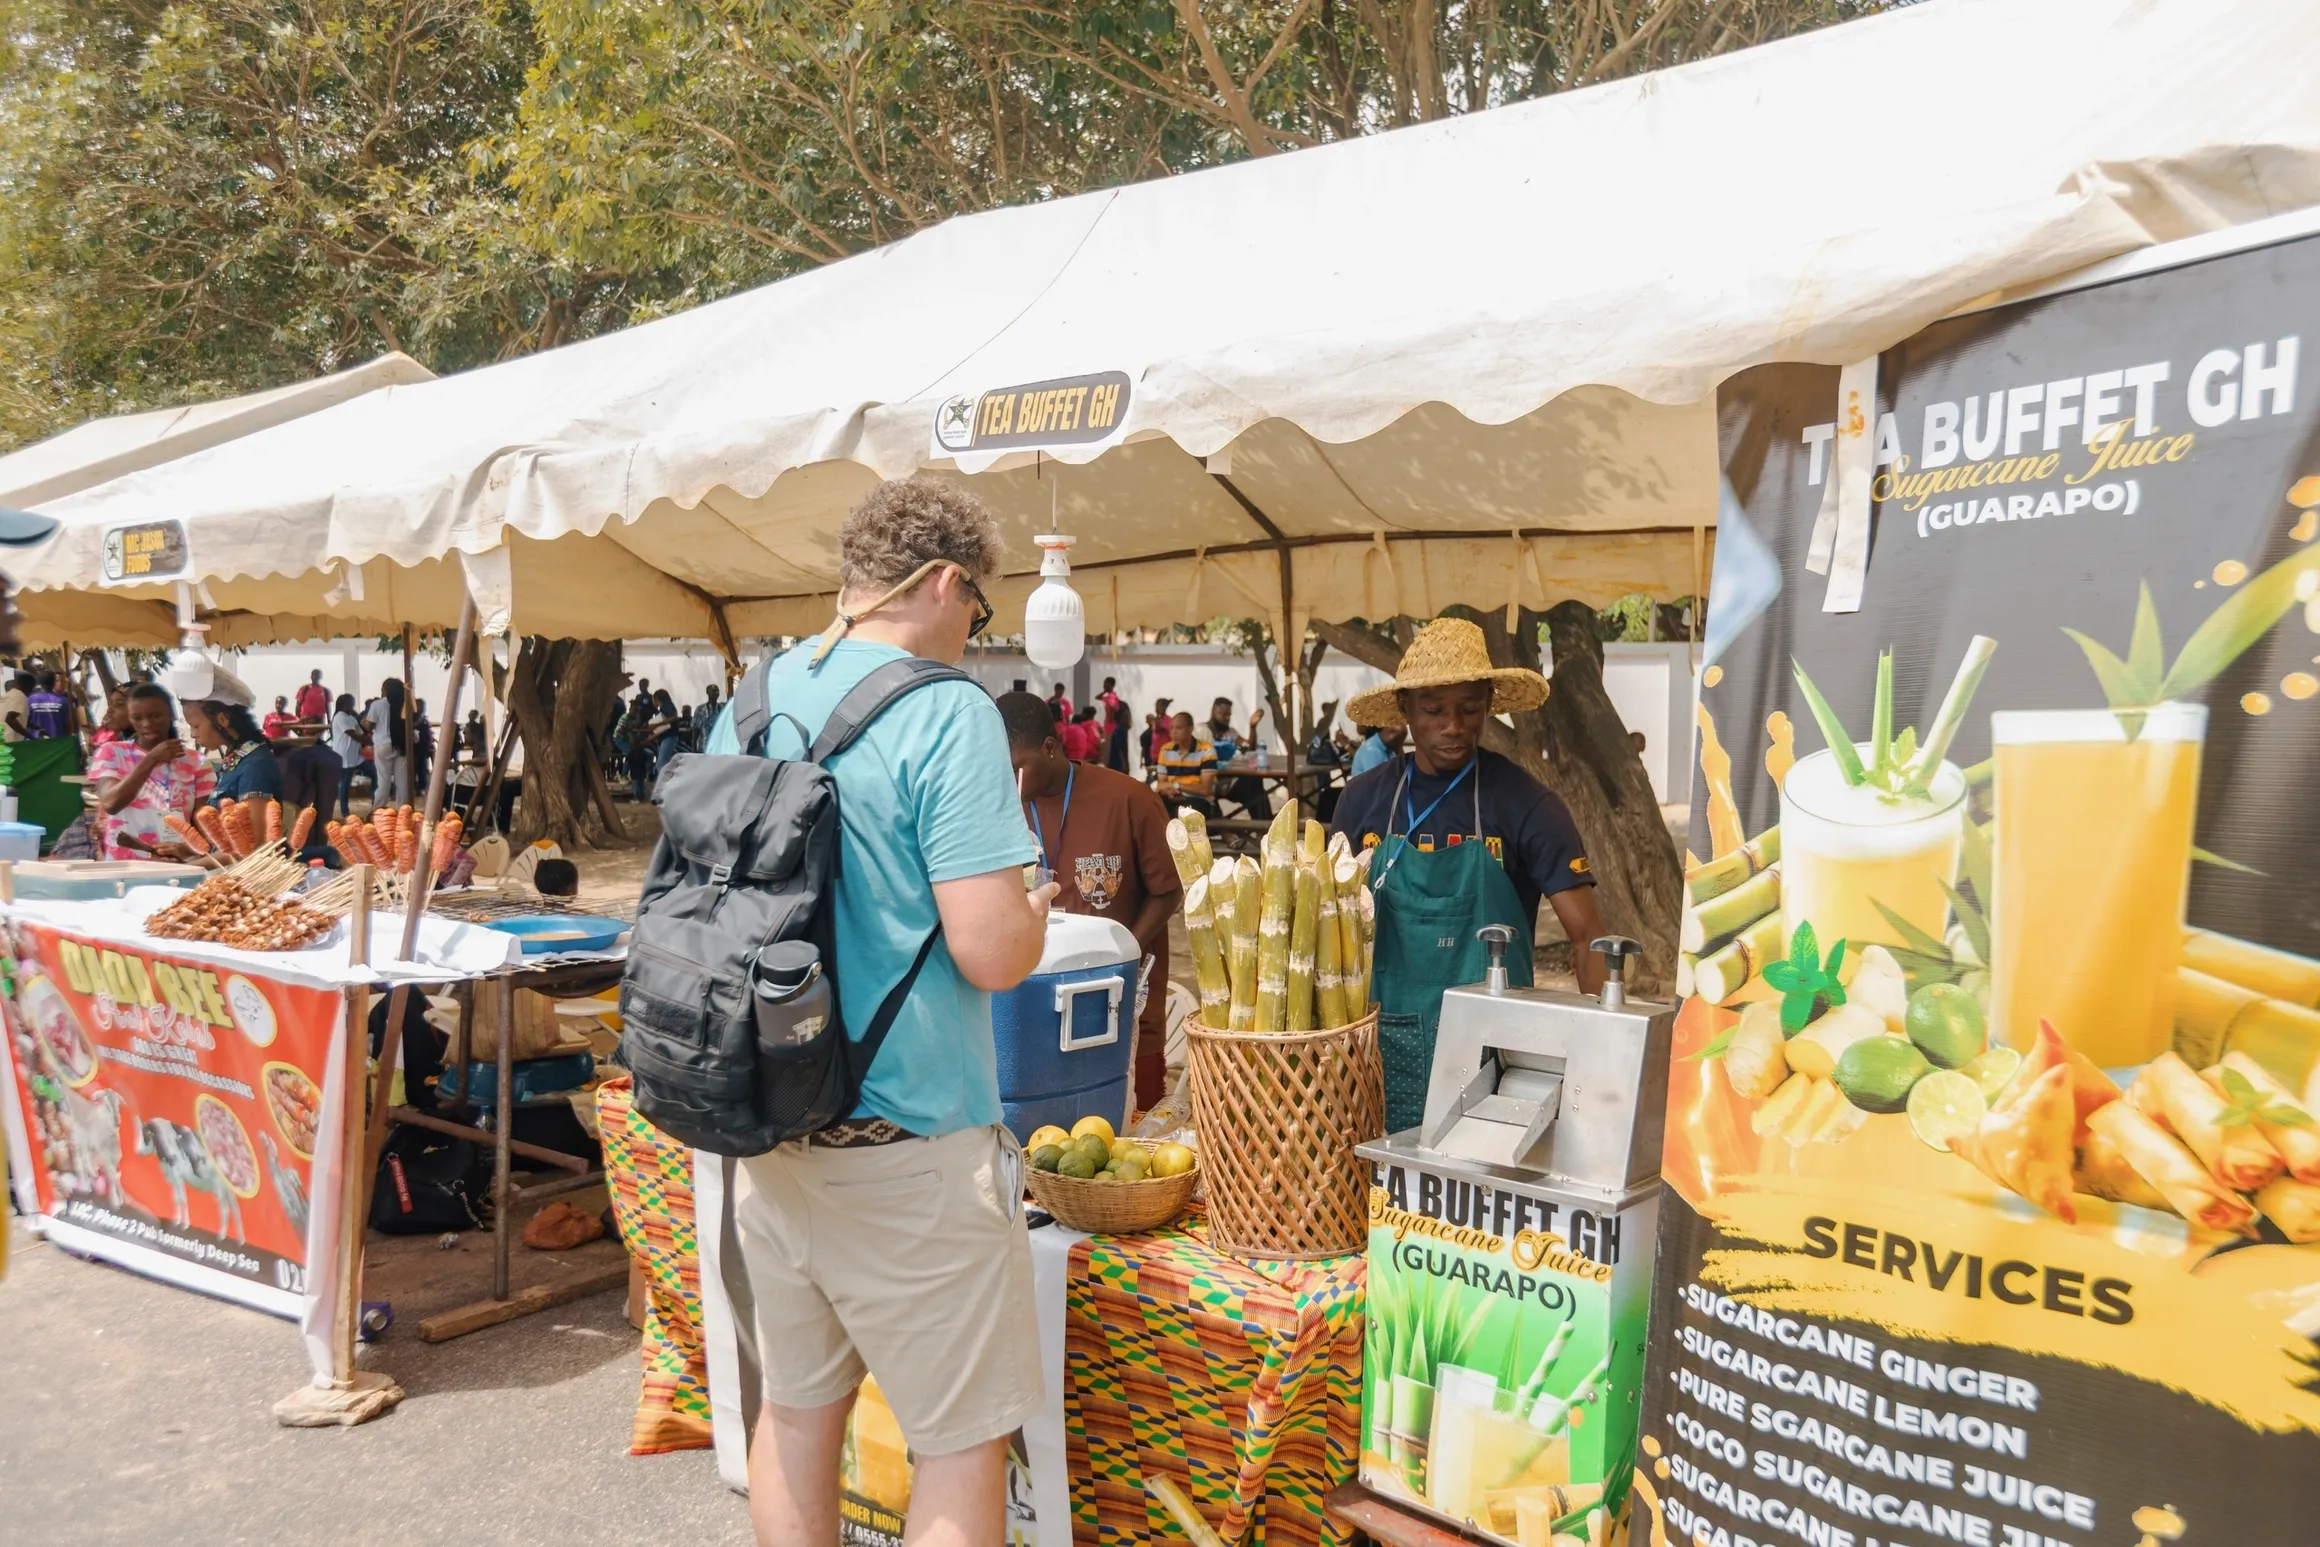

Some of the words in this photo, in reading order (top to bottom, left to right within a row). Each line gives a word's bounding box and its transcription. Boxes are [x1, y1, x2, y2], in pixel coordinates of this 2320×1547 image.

[980, 393, 1017, 436] TEA
[1016, 386, 1089, 434] BUFFET
[1087, 384, 1121, 429] GH
[1802, 411, 1903, 485] TA
[1921, 360, 2171, 470] BUFFET
[2186, 335, 2301, 428] GH
[1871, 452, 2060, 513] Sugarcane
[2064, 416, 2197, 486] Juice
[1917, 479, 2141, 538] (GUARAPO)
[153, 959, 235, 1029] BEE
[92, 1208, 129, 1232] Phase
[127, 1219, 137, 1234] 2
[136, 1221, 158, 1241] Pub
[157, 1229, 205, 1259] formerly
[207, 1243, 237, 1267] Deep
[237, 1254, 260, 1273] Sea
[1370, 1186, 1505, 1254] Sugarcane
[1512, 1228, 1613, 1283] Juice
[1419, 1171, 1559, 1240] BUFFET
[1569, 1208, 1621, 1266] GH
[1392, 1240, 1576, 1321] (GUARAPO)
[1801, 1215, 2136, 1327] SERVICES
[1682, 1326, 1870, 1419] SUGARCANE
[1874, 1395, 2028, 1460] LEMON
[1686, 1283, 1876, 1371] SUGARCANE
[1880, 1349, 2039, 1412] GINGER
[1675, 1411, 1748, 1469] COCO
[1753, 1450, 1993, 1547] SUGARCANE
[1679, 1367, 1745, 1423] PURE
[1750, 1403, 1955, 1490] SGARCANE
[1961, 1464, 2096, 1532] JUICE
[872, 1510, 900, 1533] NOW
[1666, 1496, 1778, 1547] SUGAR
[1671, 1454, 1857, 1547] SUGARCANE
